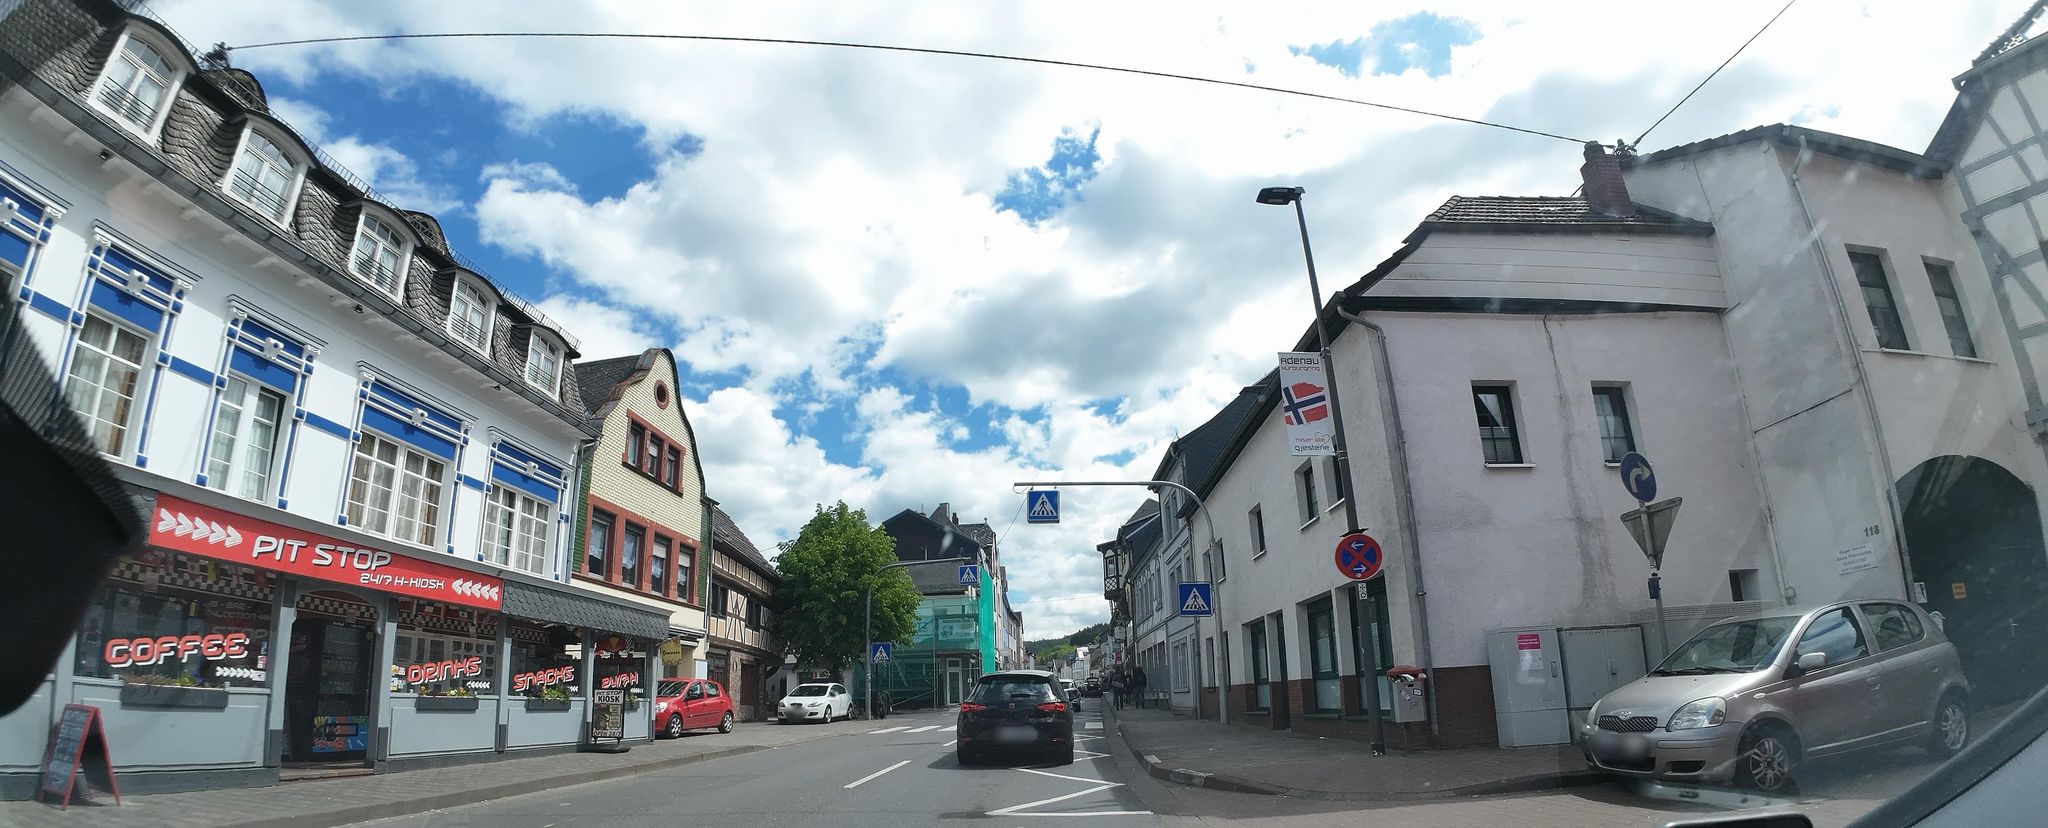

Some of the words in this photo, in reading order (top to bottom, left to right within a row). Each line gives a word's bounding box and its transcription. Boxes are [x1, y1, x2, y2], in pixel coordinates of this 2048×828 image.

[1280, 356, 1319, 365] Adenau
[1863, 524, 1880, 537] 118
[252, 535, 307, 562] PIT
[312, 543, 392, 571] STOP
[360, 573, 392, 586] 24/7
[394, 576, 445, 590] H-KIOSK
[104, 632, 249, 668] COFFEE
[407, 656, 482, 685] DRINKS
[513, 665, 575, 692] SNACKS
[597, 695, 620, 703] KIOSK
